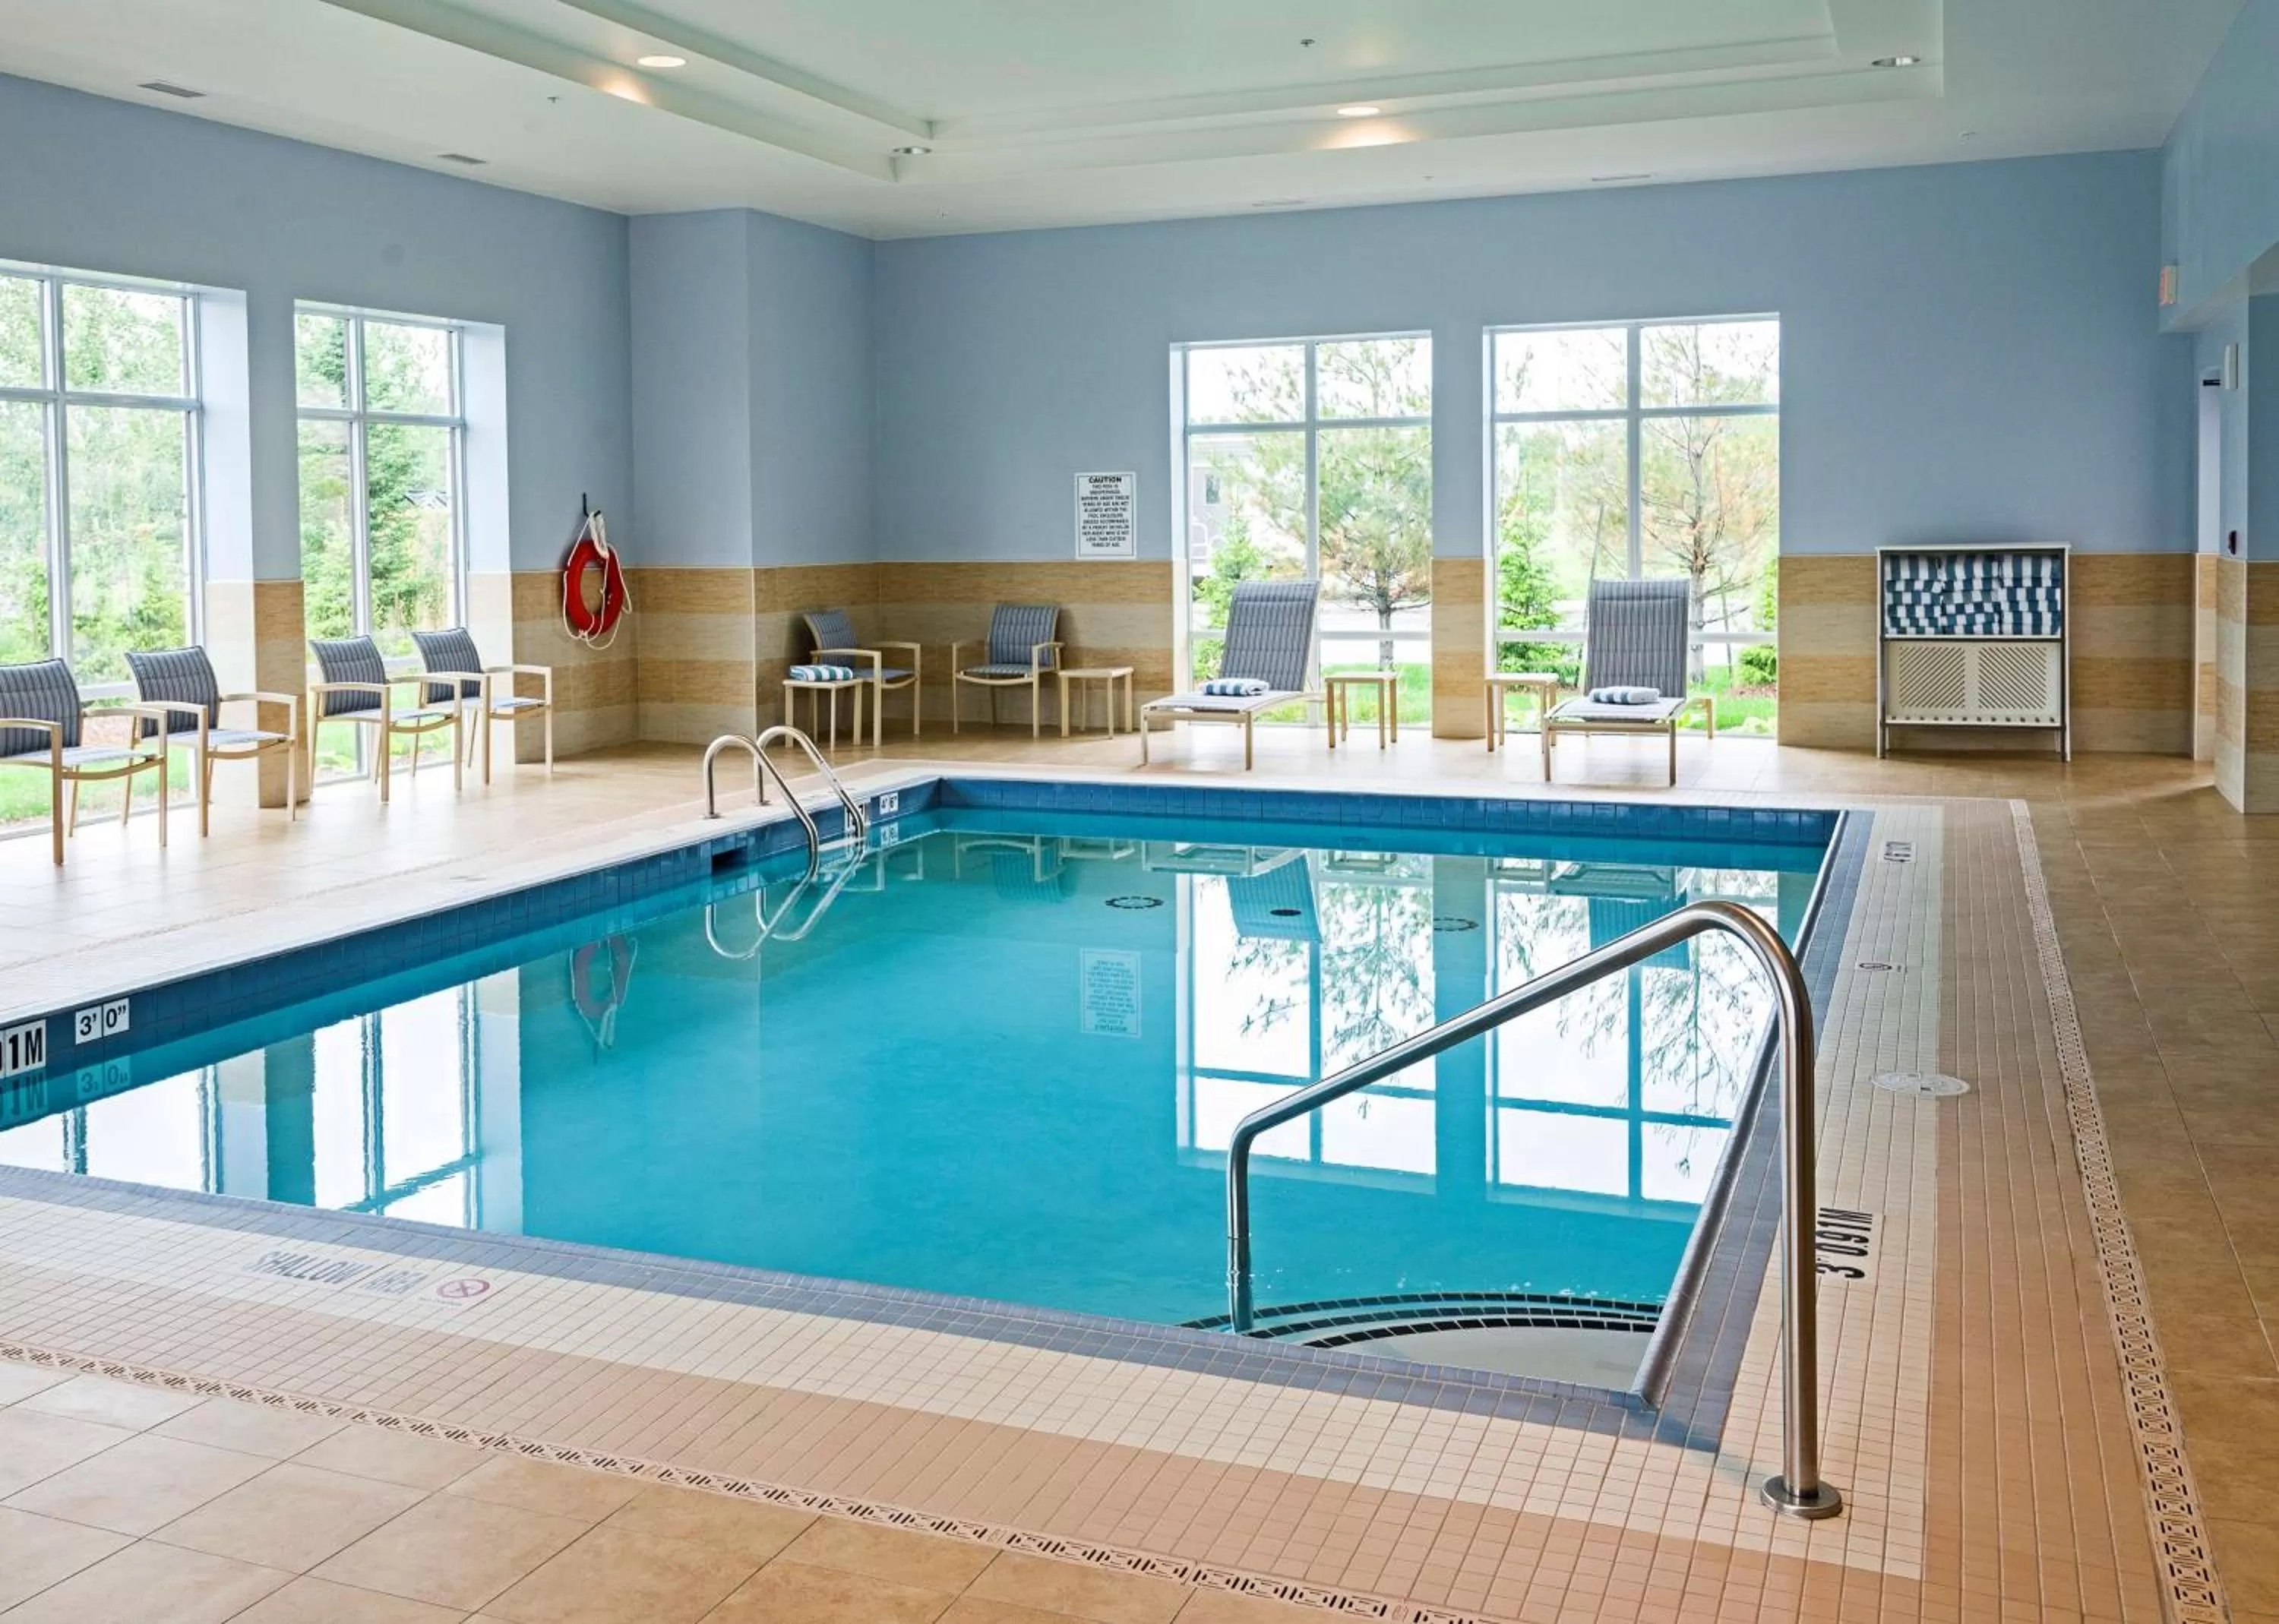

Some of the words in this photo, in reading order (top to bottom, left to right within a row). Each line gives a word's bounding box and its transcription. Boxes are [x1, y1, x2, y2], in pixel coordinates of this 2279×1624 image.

[80, 1013, 97, 1036] 3'
[0, 1028, 43, 1071] 1M
[247, 1251, 373, 1284] SHALLOW
[359, 1269, 429, 1294] AREA
